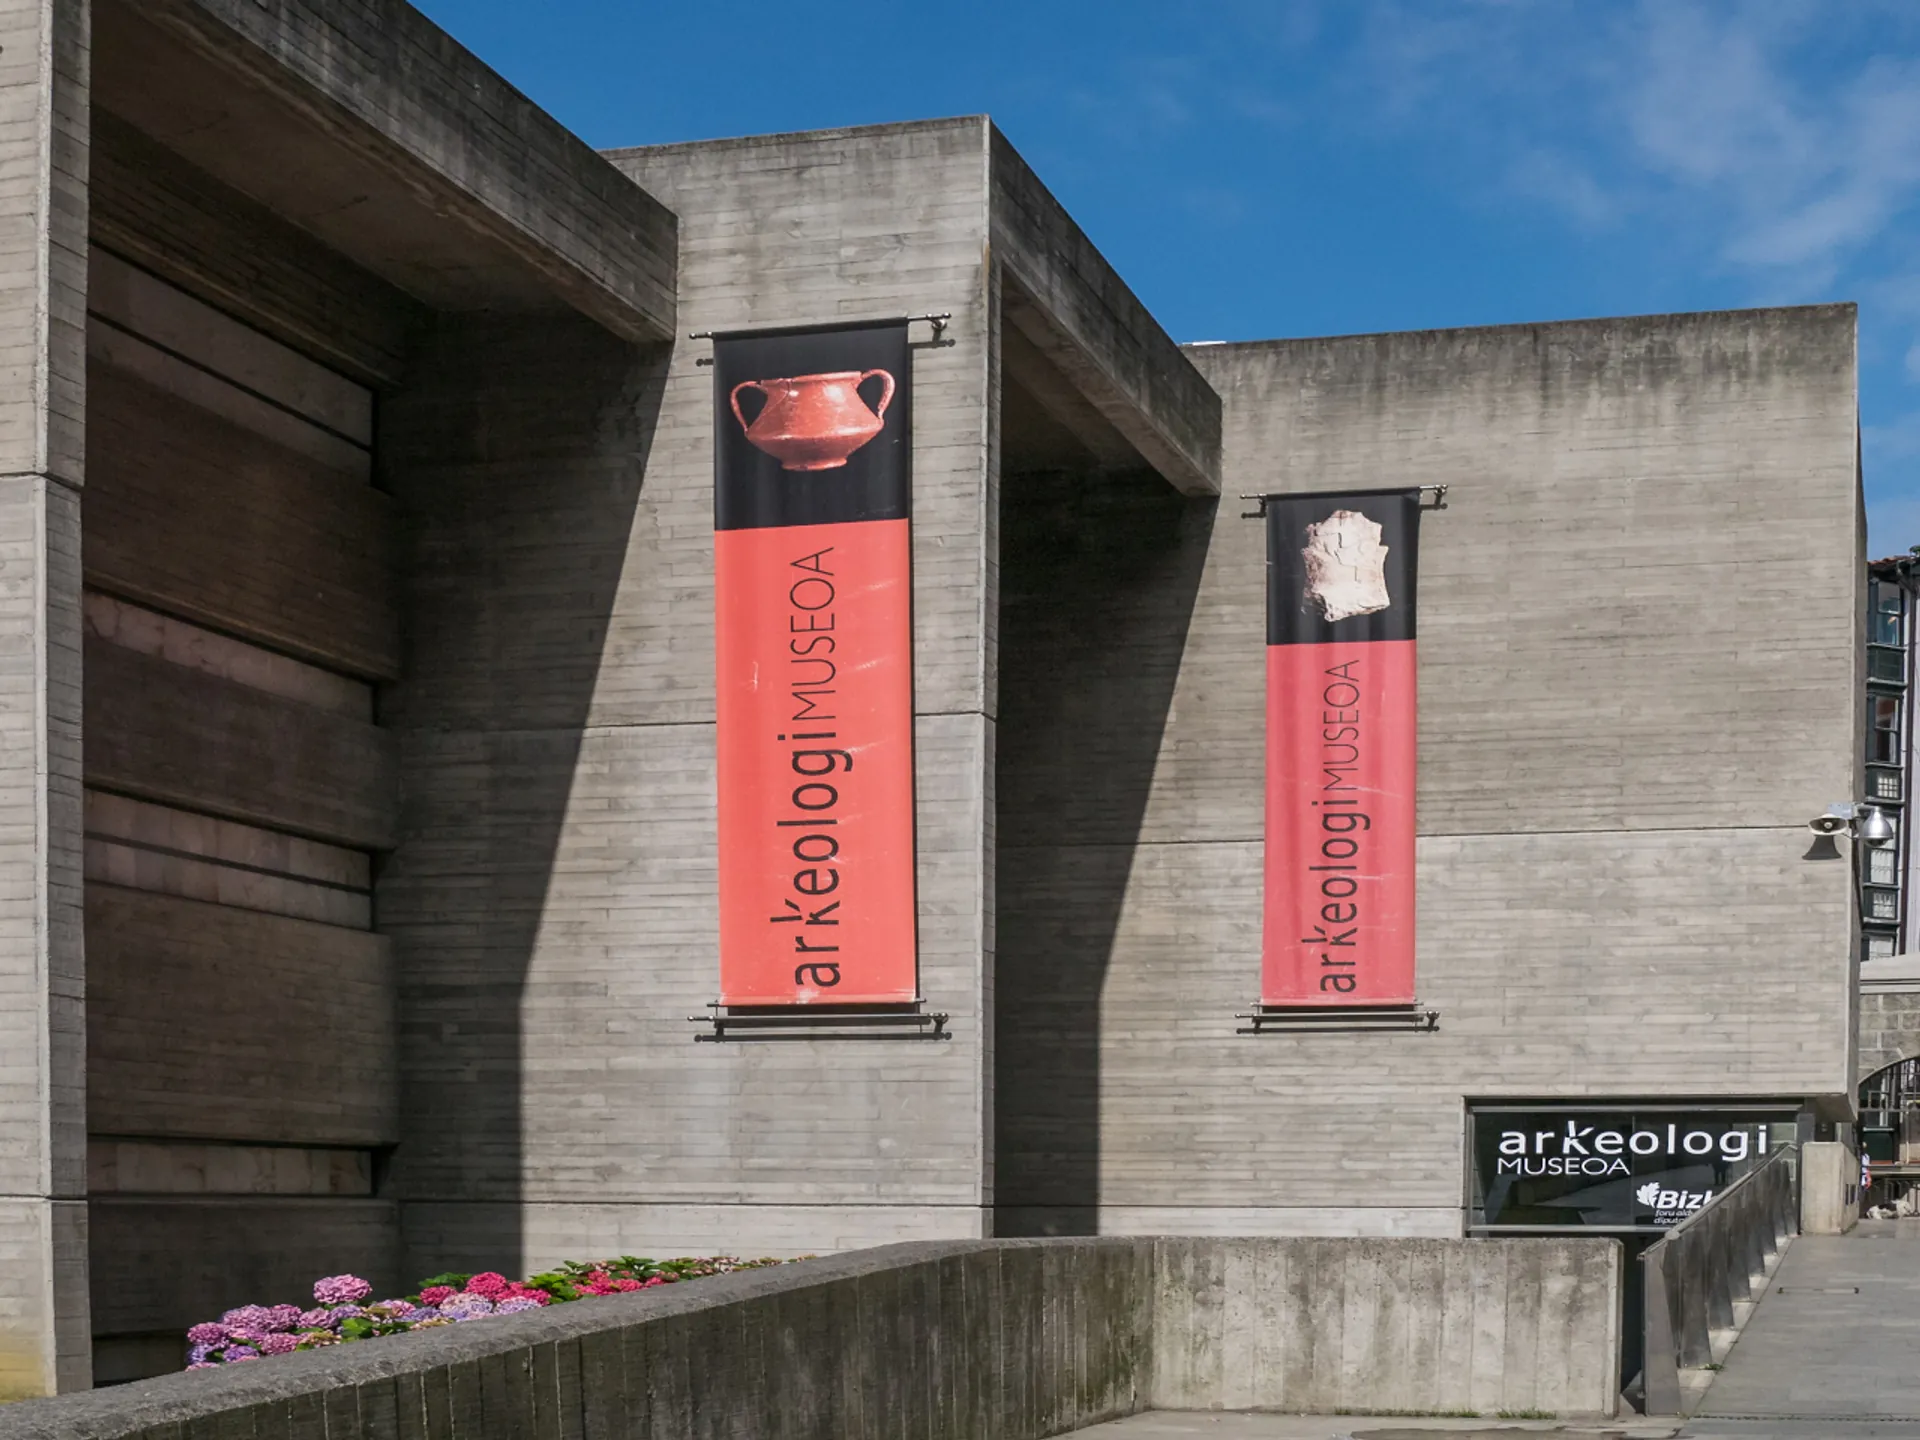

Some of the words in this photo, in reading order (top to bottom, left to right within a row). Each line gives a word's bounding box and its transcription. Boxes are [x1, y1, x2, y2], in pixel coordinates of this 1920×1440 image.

[789, 547, 837, 721] MUSEOA
[1323, 659, 1360, 791] MUSEOA
[769, 732, 853, 988] arkeologi
[1301, 799, 1371, 993] arkeologi
[1496, 1157, 1631, 1176] MUSEOA
[1498, 1120, 1767, 1162] arkeologi
